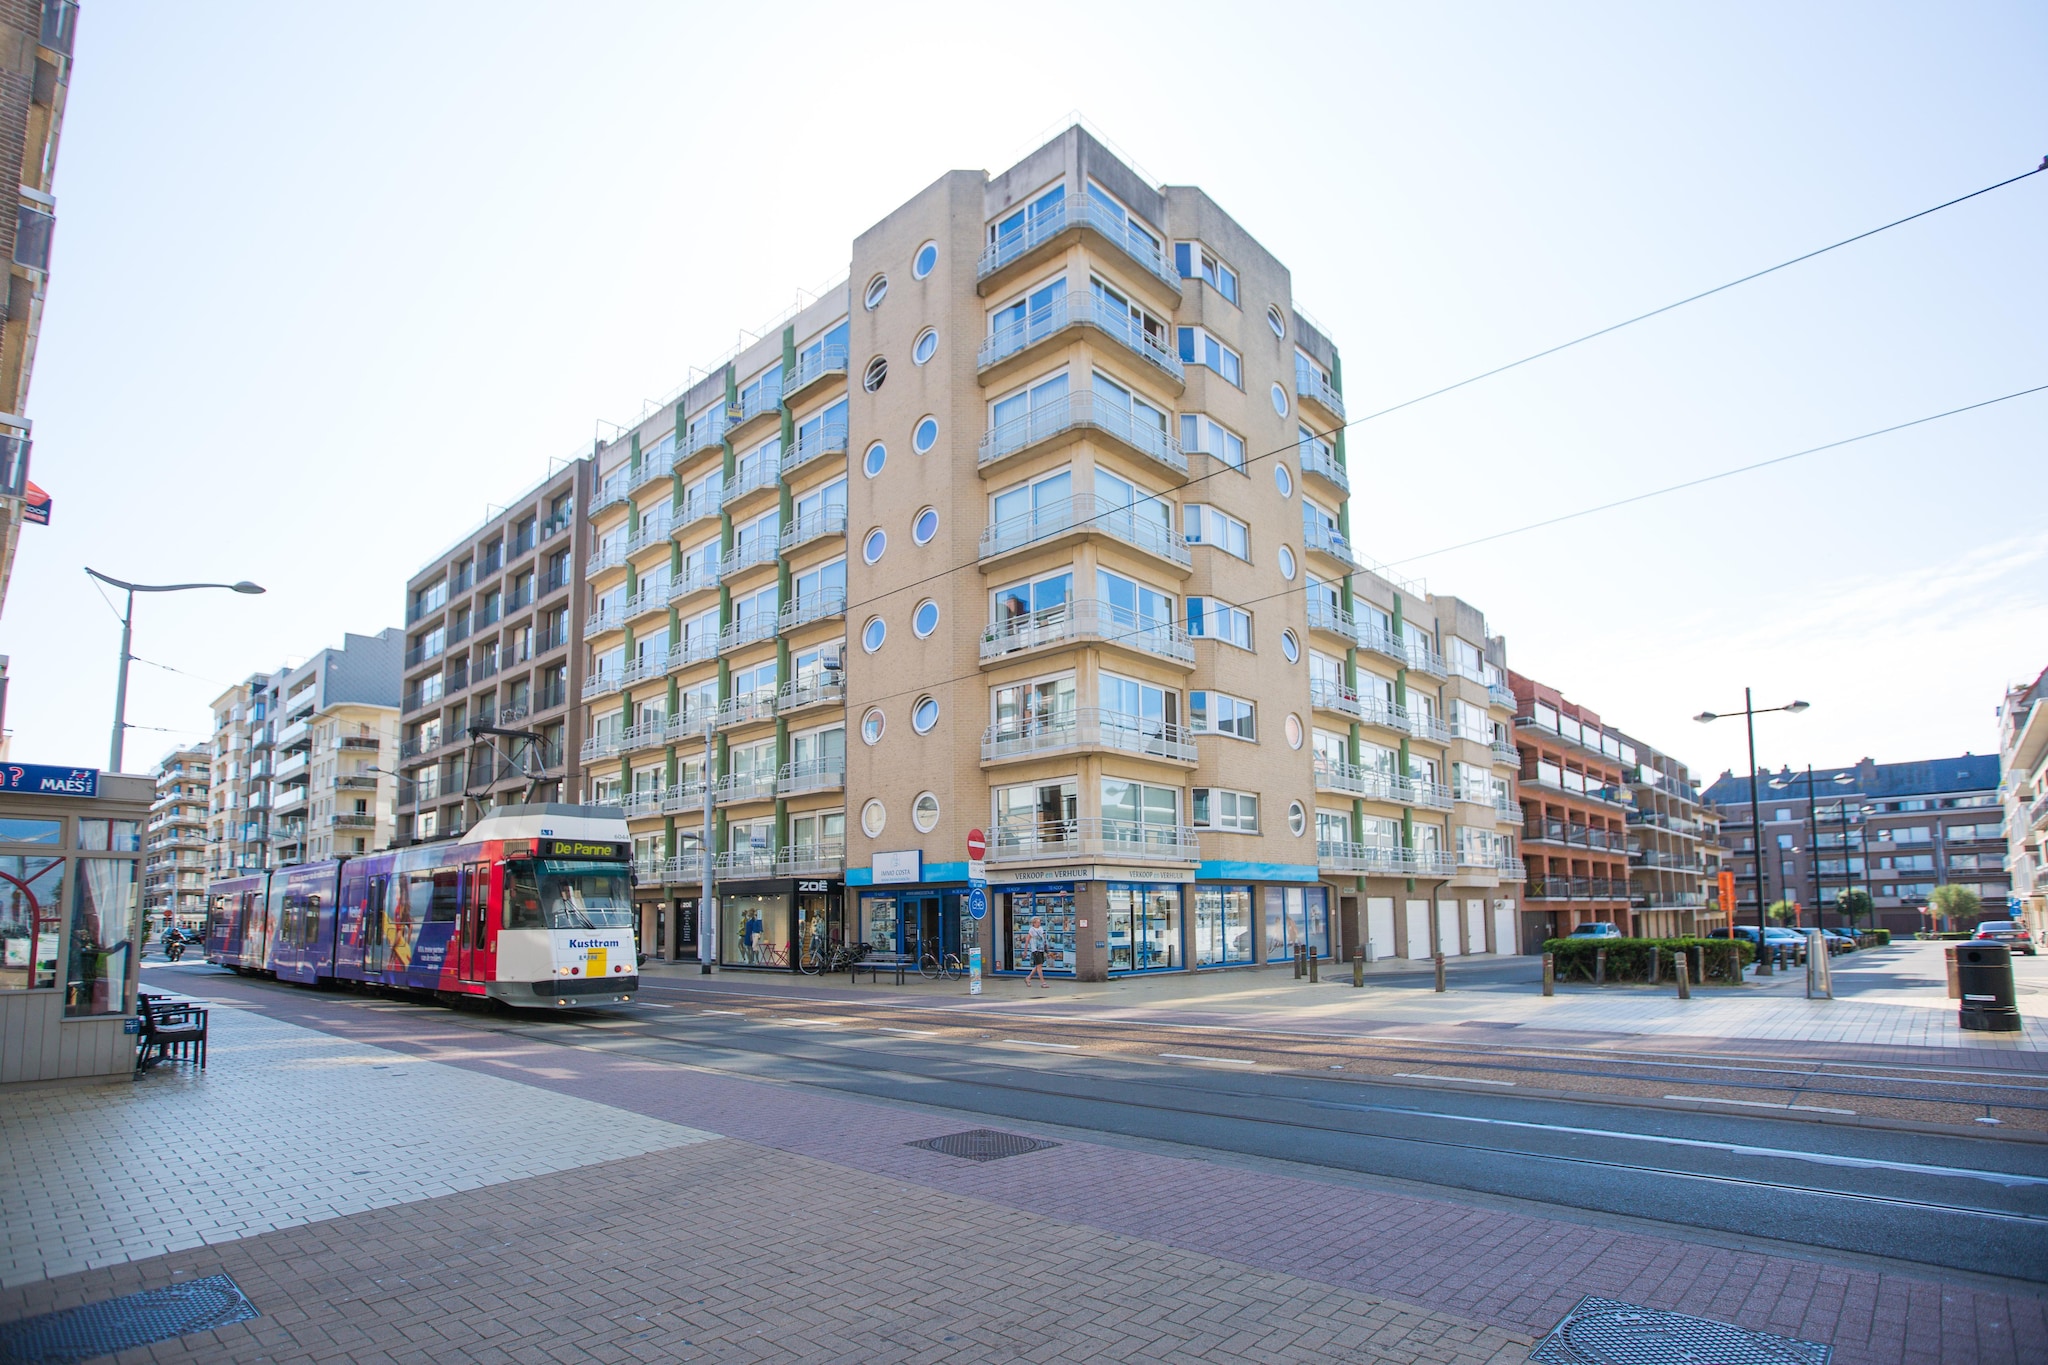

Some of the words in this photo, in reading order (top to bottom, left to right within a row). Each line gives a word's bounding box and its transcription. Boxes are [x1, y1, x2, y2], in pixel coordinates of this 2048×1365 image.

[40, 778, 85, 793] MAES
[555, 842, 571, 854] De
[574, 843, 611, 856] Panne
[1015, 872, 1044, 880] VERKOOP
[1054, 869, 1088, 878] VERHUUR
[799, 880, 828, 892] ZOË
[569, 939, 619, 949] Kusttram
